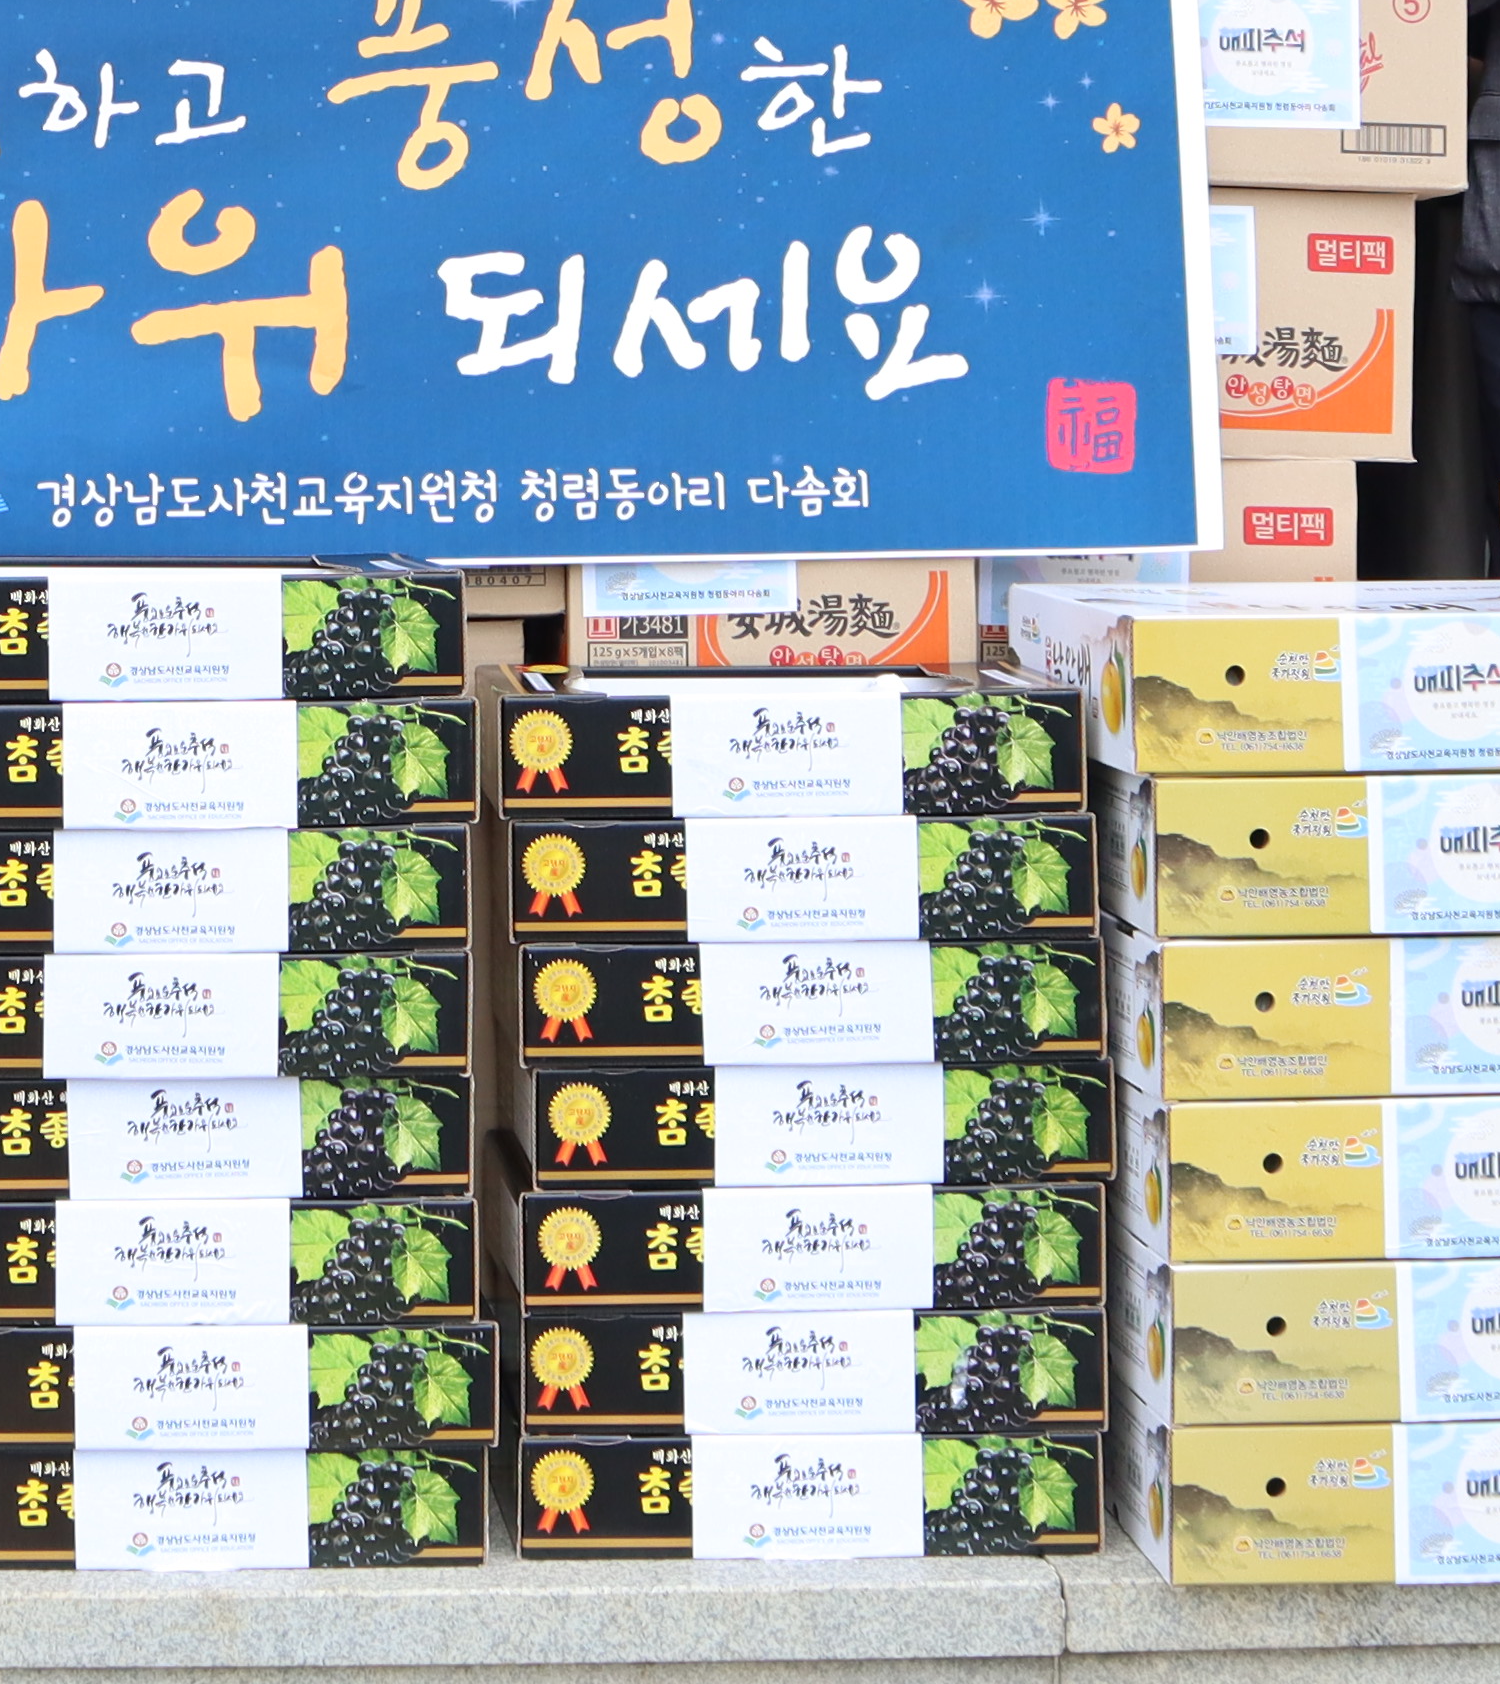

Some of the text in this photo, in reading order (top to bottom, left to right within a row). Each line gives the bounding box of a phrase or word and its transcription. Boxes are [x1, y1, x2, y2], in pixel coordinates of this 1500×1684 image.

[1314, 238, 1387, 270] 멀티팩
[437, 224, 969, 401] 되세요
[1226, 375, 1316, 407] 안성탕면
[37, 465, 871, 528] 경상남도사천교육지원청 청렴동아리 다솜회
[1251, 511, 1326, 541] 멀티팩
